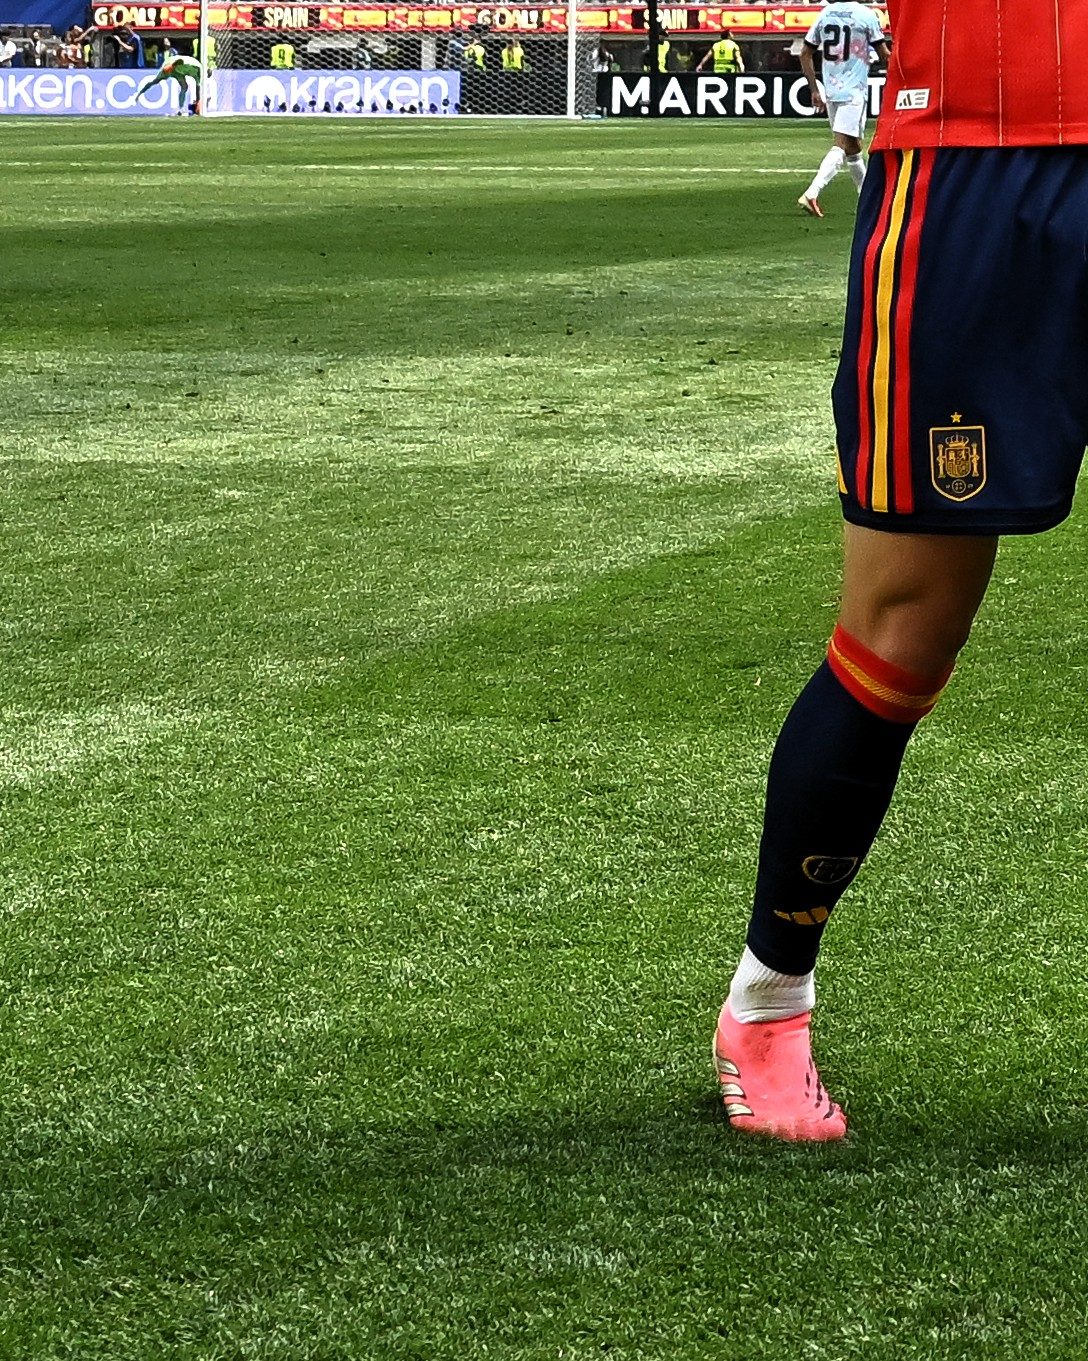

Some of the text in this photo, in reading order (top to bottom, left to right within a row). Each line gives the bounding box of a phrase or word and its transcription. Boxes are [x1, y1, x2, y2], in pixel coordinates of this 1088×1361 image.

[94, 5, 157, 28] GOAL!
[264, 6, 309, 28] SPAIN
[823, 24, 851, 61] 21
[290, 72, 449, 111] kraken
[611, 76, 887, 115] MARRIOT
